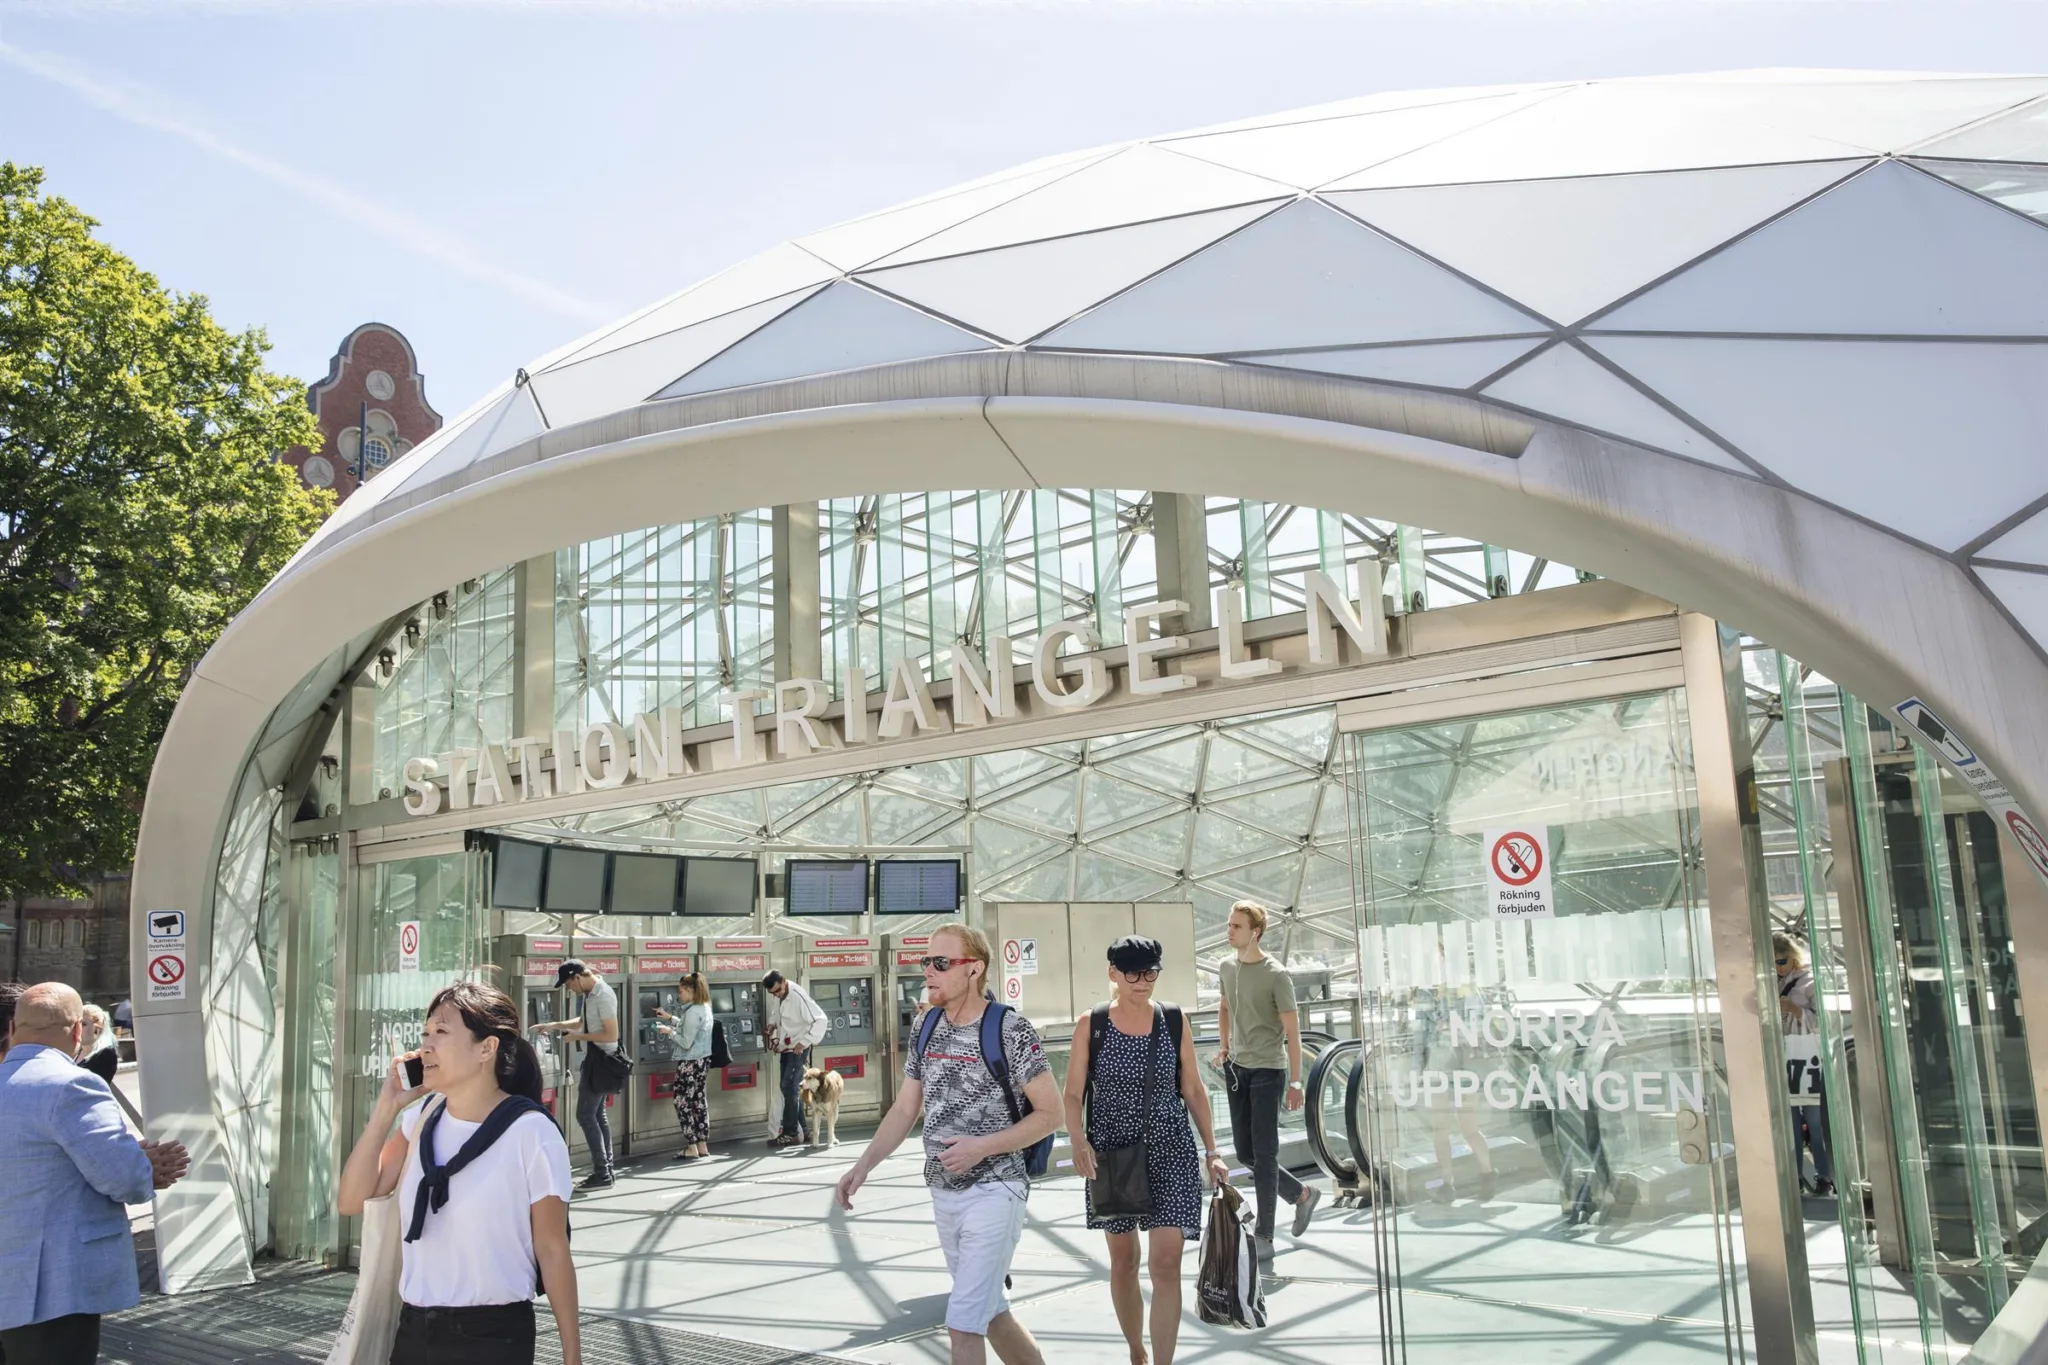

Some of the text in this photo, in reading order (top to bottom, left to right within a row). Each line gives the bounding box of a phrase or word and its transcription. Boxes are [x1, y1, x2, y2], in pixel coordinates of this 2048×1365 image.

[403, 559, 1390, 816] STATION TRIANGELN
[1499, 889, 1541, 901] Rökning
[1497, 902, 1546, 916] förbjuden
[641, 960, 686, 970] Biljetter Tickets
[813, 954, 868, 964] Biljetter Tickets
[382, 1022, 424, 1044] NORR
[1449, 1007, 1627, 1048] NORRA
[1390, 1063, 1705, 1113] UPPGÅNGEN
